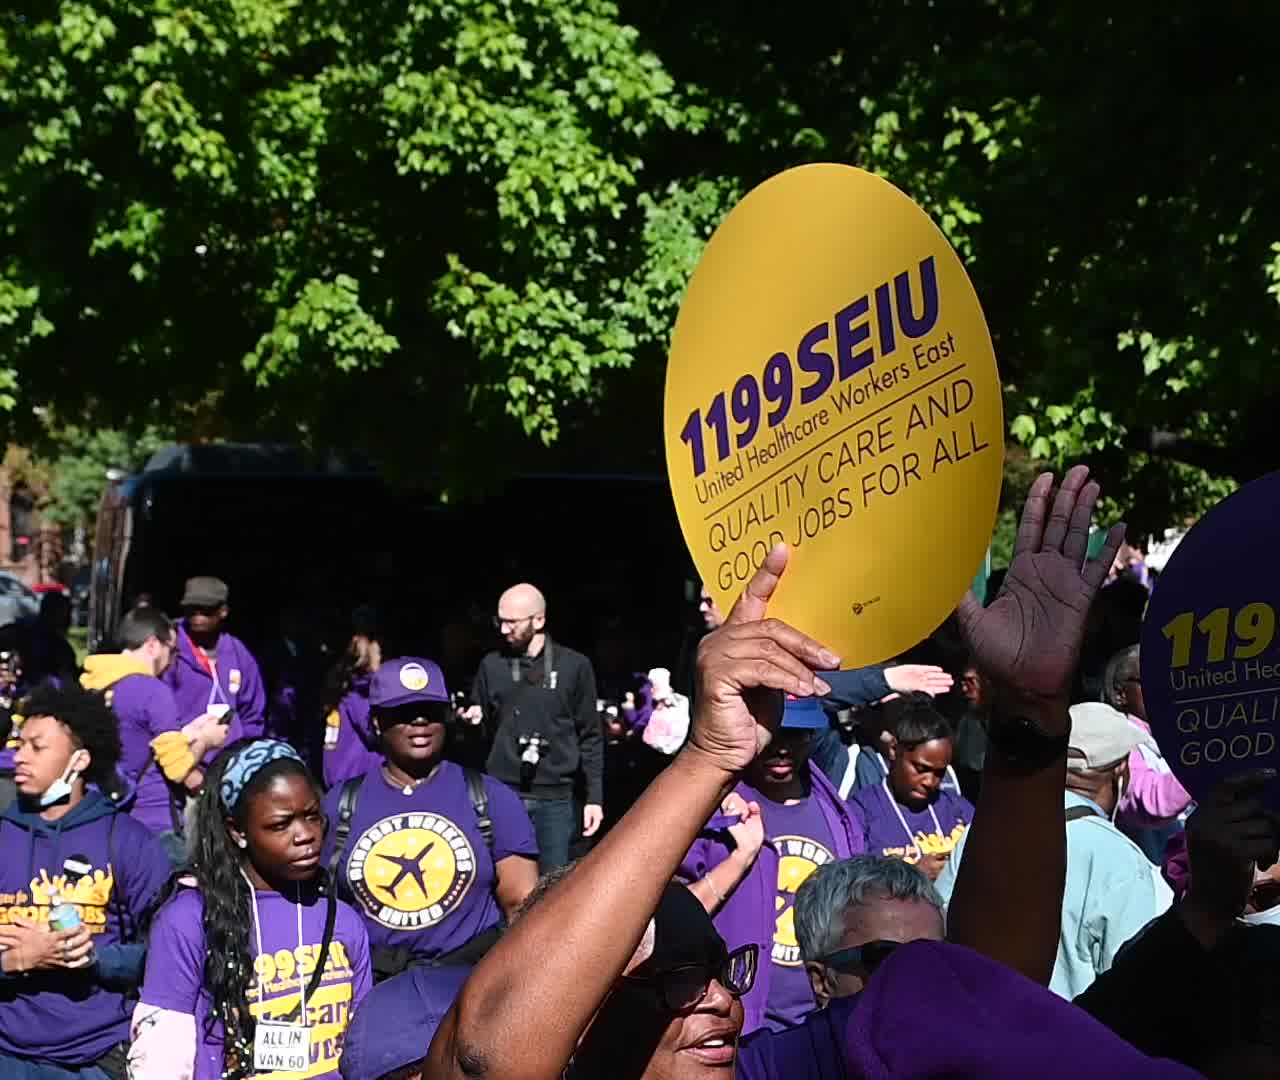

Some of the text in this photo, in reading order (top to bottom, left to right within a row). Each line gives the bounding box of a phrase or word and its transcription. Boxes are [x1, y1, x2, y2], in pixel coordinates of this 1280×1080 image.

[680, 256, 939, 477] 1199SEIU
[695, 333, 956, 504] United Healthcare Workers East
[710, 378, 975, 553] QUALITY CARE AND
[793, 497, 853, 548] JOBS
[862, 452, 921, 507] FOR
[931, 421, 989, 473] ALL
[1170, 665, 1238, 691] United
[1179, 731, 1276, 767] GOOD
[408, 815, 472, 872] WORKERS
[378, 904, 443, 926] UNITED
[259, 1055, 304, 1068] VAN 60
[263, 1031, 302, 1046] ALL IN
